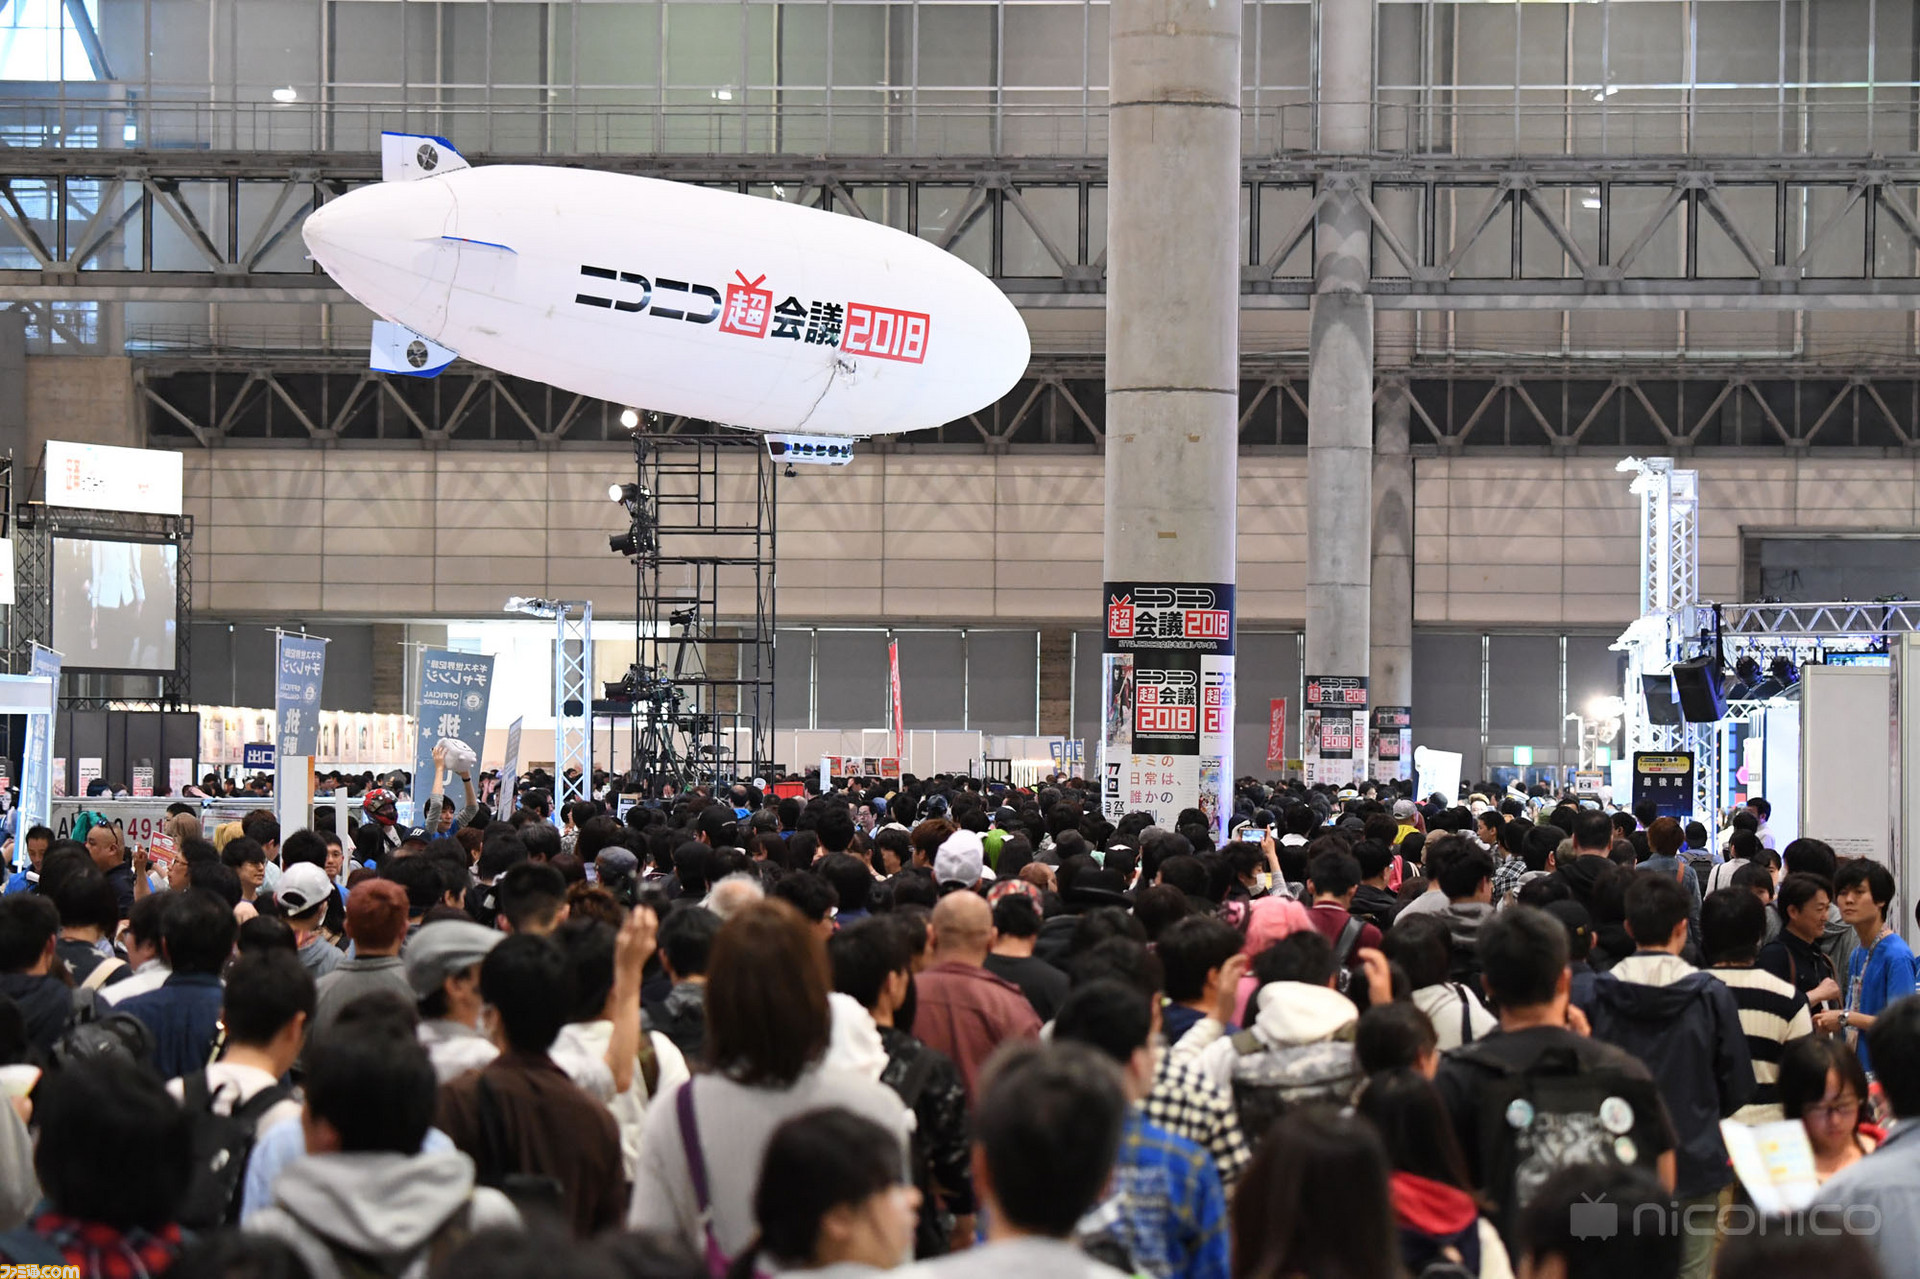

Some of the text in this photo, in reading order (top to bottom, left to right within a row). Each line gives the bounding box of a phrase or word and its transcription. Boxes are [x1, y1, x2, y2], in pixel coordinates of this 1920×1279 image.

[1135, 588, 1215, 609] ニコニコ
[1109, 604, 1229, 639] 超会議2018
[1136, 669, 1197, 686] ニコニコ
[1137, 686, 1196, 706] 超会議
[1140, 708, 1192, 730] 2018
[247, 749, 275, 763] 出口
[1131, 754, 1175, 767] キミの
[1130, 772, 1182, 786] 日常は、
[1130, 790, 1174, 804] 誰かの
